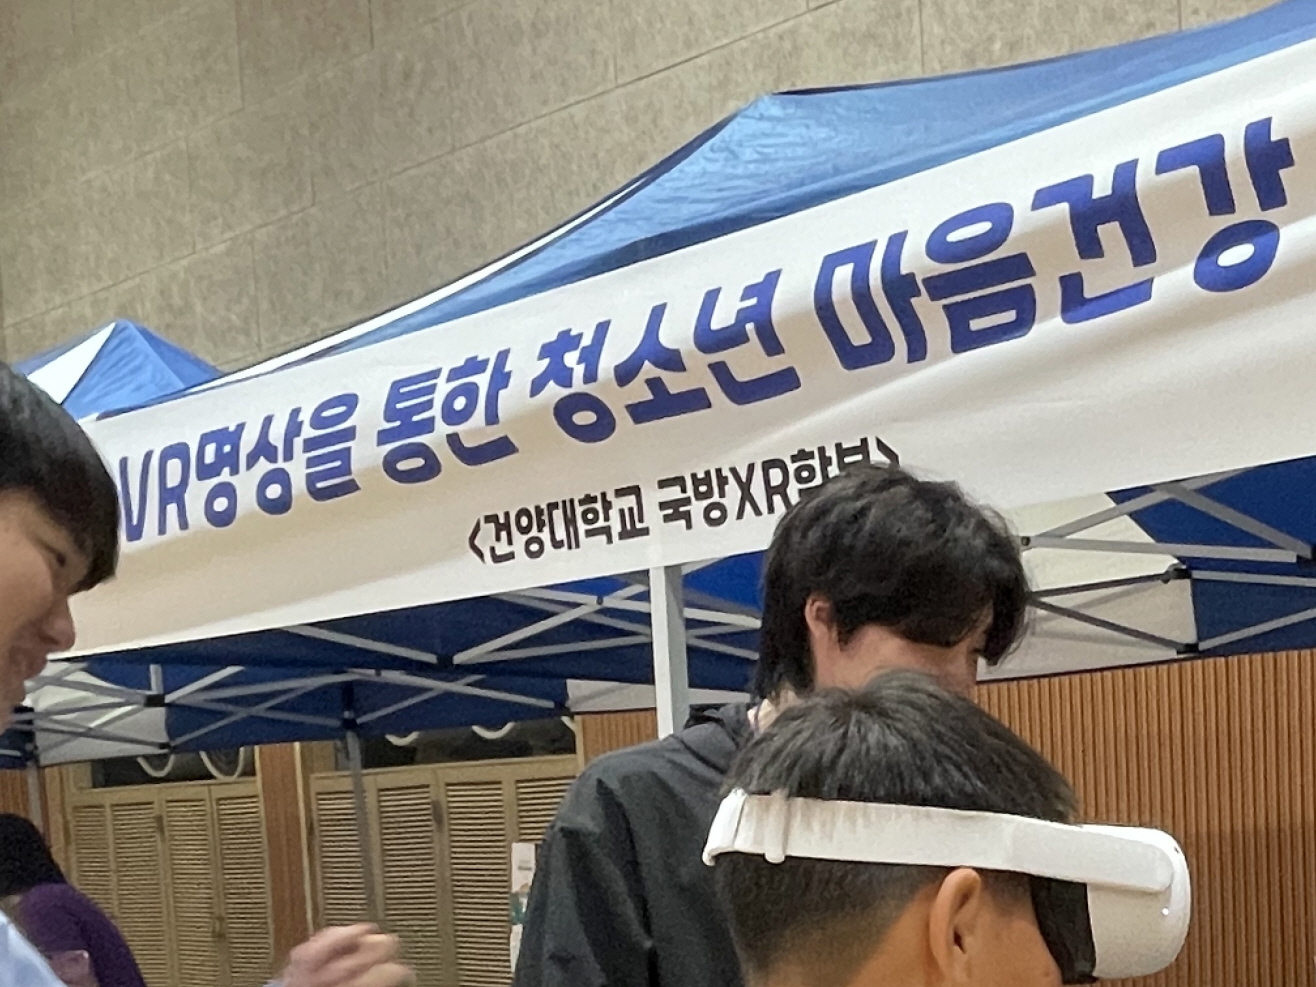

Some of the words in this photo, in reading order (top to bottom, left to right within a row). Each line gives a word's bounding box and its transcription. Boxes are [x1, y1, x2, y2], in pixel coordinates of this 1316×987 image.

[118, 393, 361, 542] VR명상을
[376, 347, 520, 485] 통한
[529, 268, 802, 443] 청소년
[813, 116, 1296, 371] 마음건강
[467, 485, 650, 565] <건양대학교
